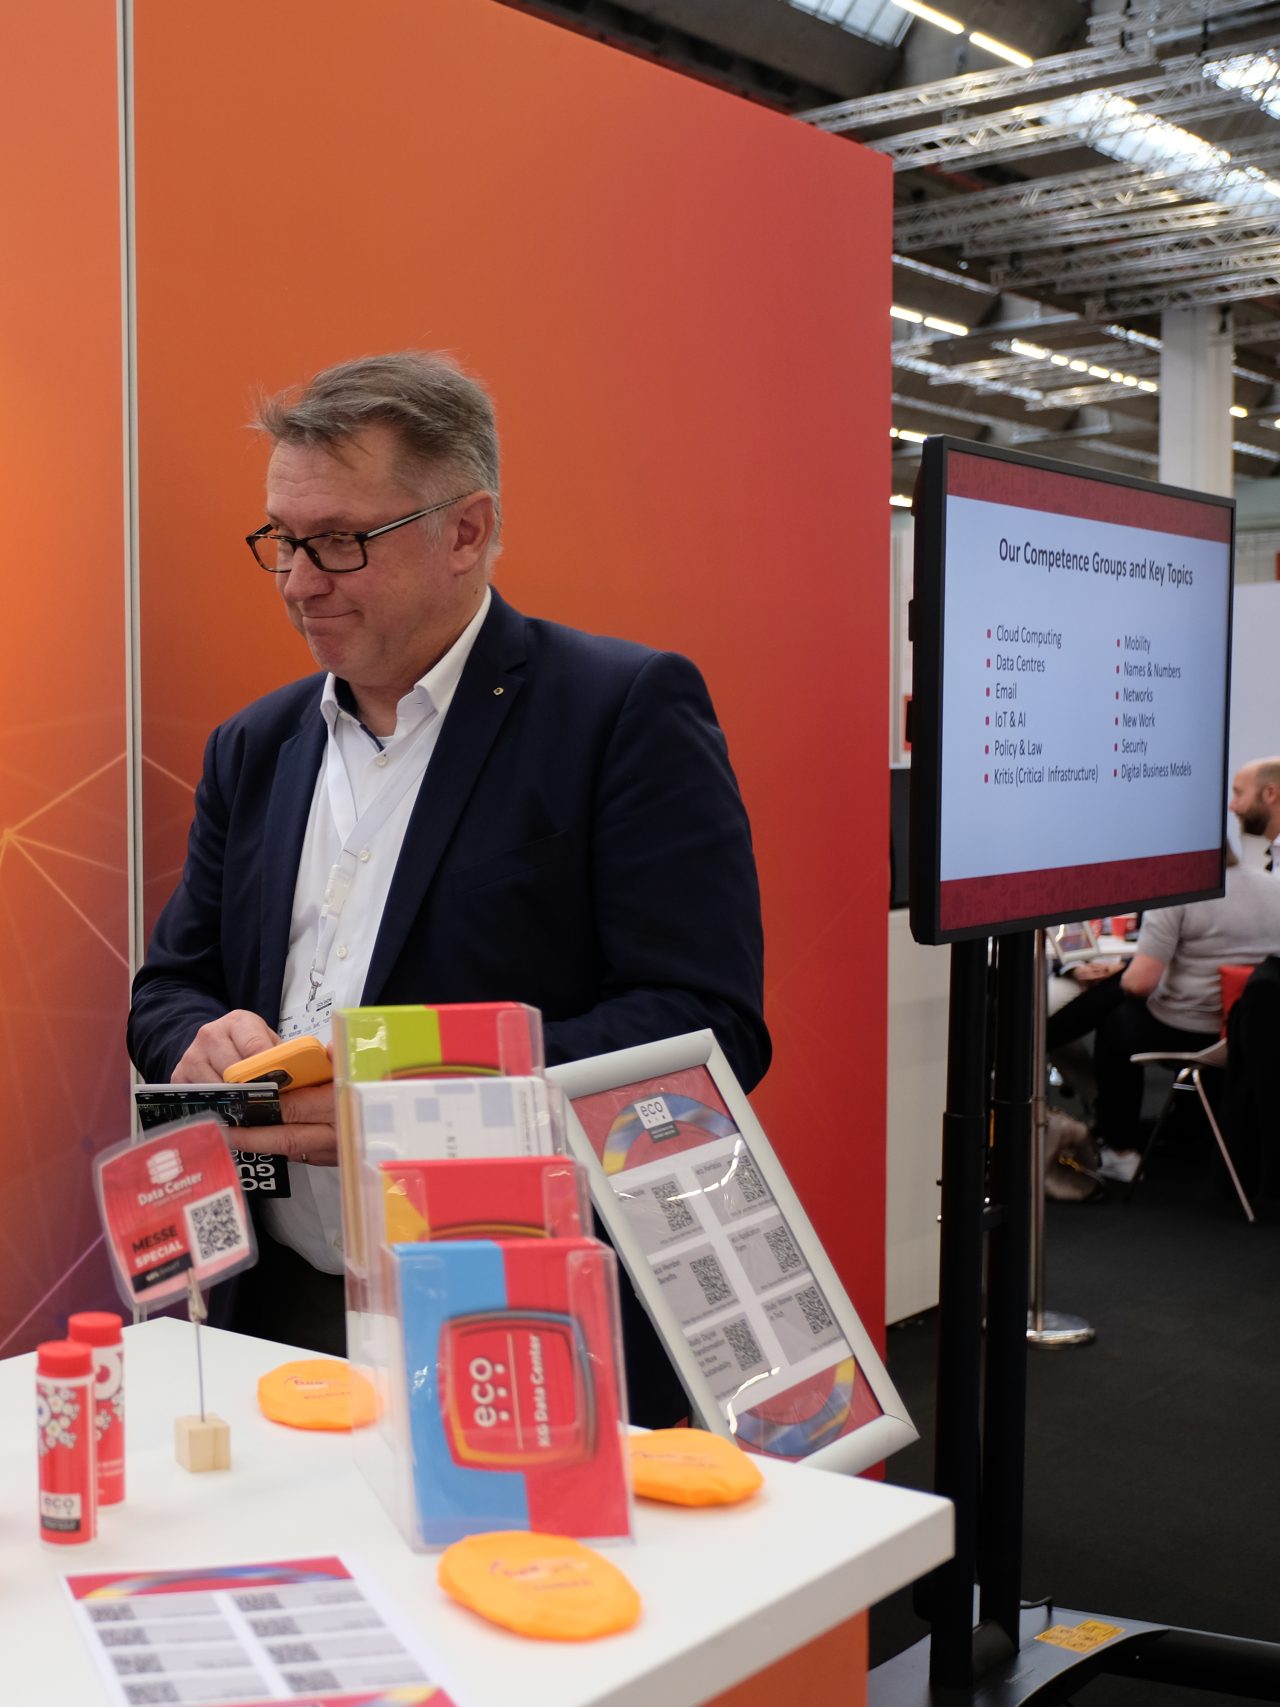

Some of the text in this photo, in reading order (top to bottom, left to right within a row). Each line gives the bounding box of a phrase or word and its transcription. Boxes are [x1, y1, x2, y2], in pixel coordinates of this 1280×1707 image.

[999, 538, 1193, 588] Our Competence Groups and Key Topics
[996, 625, 1062, 649] Cloud Computing
[1124, 635, 1151, 655] Mobility
[996, 654, 1045, 672] Data Centres
[1124, 661, 1181, 679] Names & Numbers
[996, 682, 1017, 699] Email
[1123, 687, 1153, 703] Networks
[995, 711, 1026, 728] IoT & AI
[1123, 712, 1155, 728] New Work
[994, 739, 1042, 759] Policy & Law
[1122, 738, 1148, 756] Security
[994, 764, 1099, 787] Kritis (Critical Infrastructure)
[1121, 761, 1192, 783] Digital Business Models
[641, 1101, 663, 1117] eco
[237, 1163, 276, 1178] GU
[137, 1188, 165, 1206] Data
[164, 1172, 203, 1194] Center
[241, 1177, 277, 1192] PO
[131, 1224, 178, 1253] MESSE
[135, 1240, 184, 1268] SPECIAL
[529, 1334, 544, 1385] Center
[470, 1357, 497, 1427] eco
[534, 1386, 549, 1422] Data
